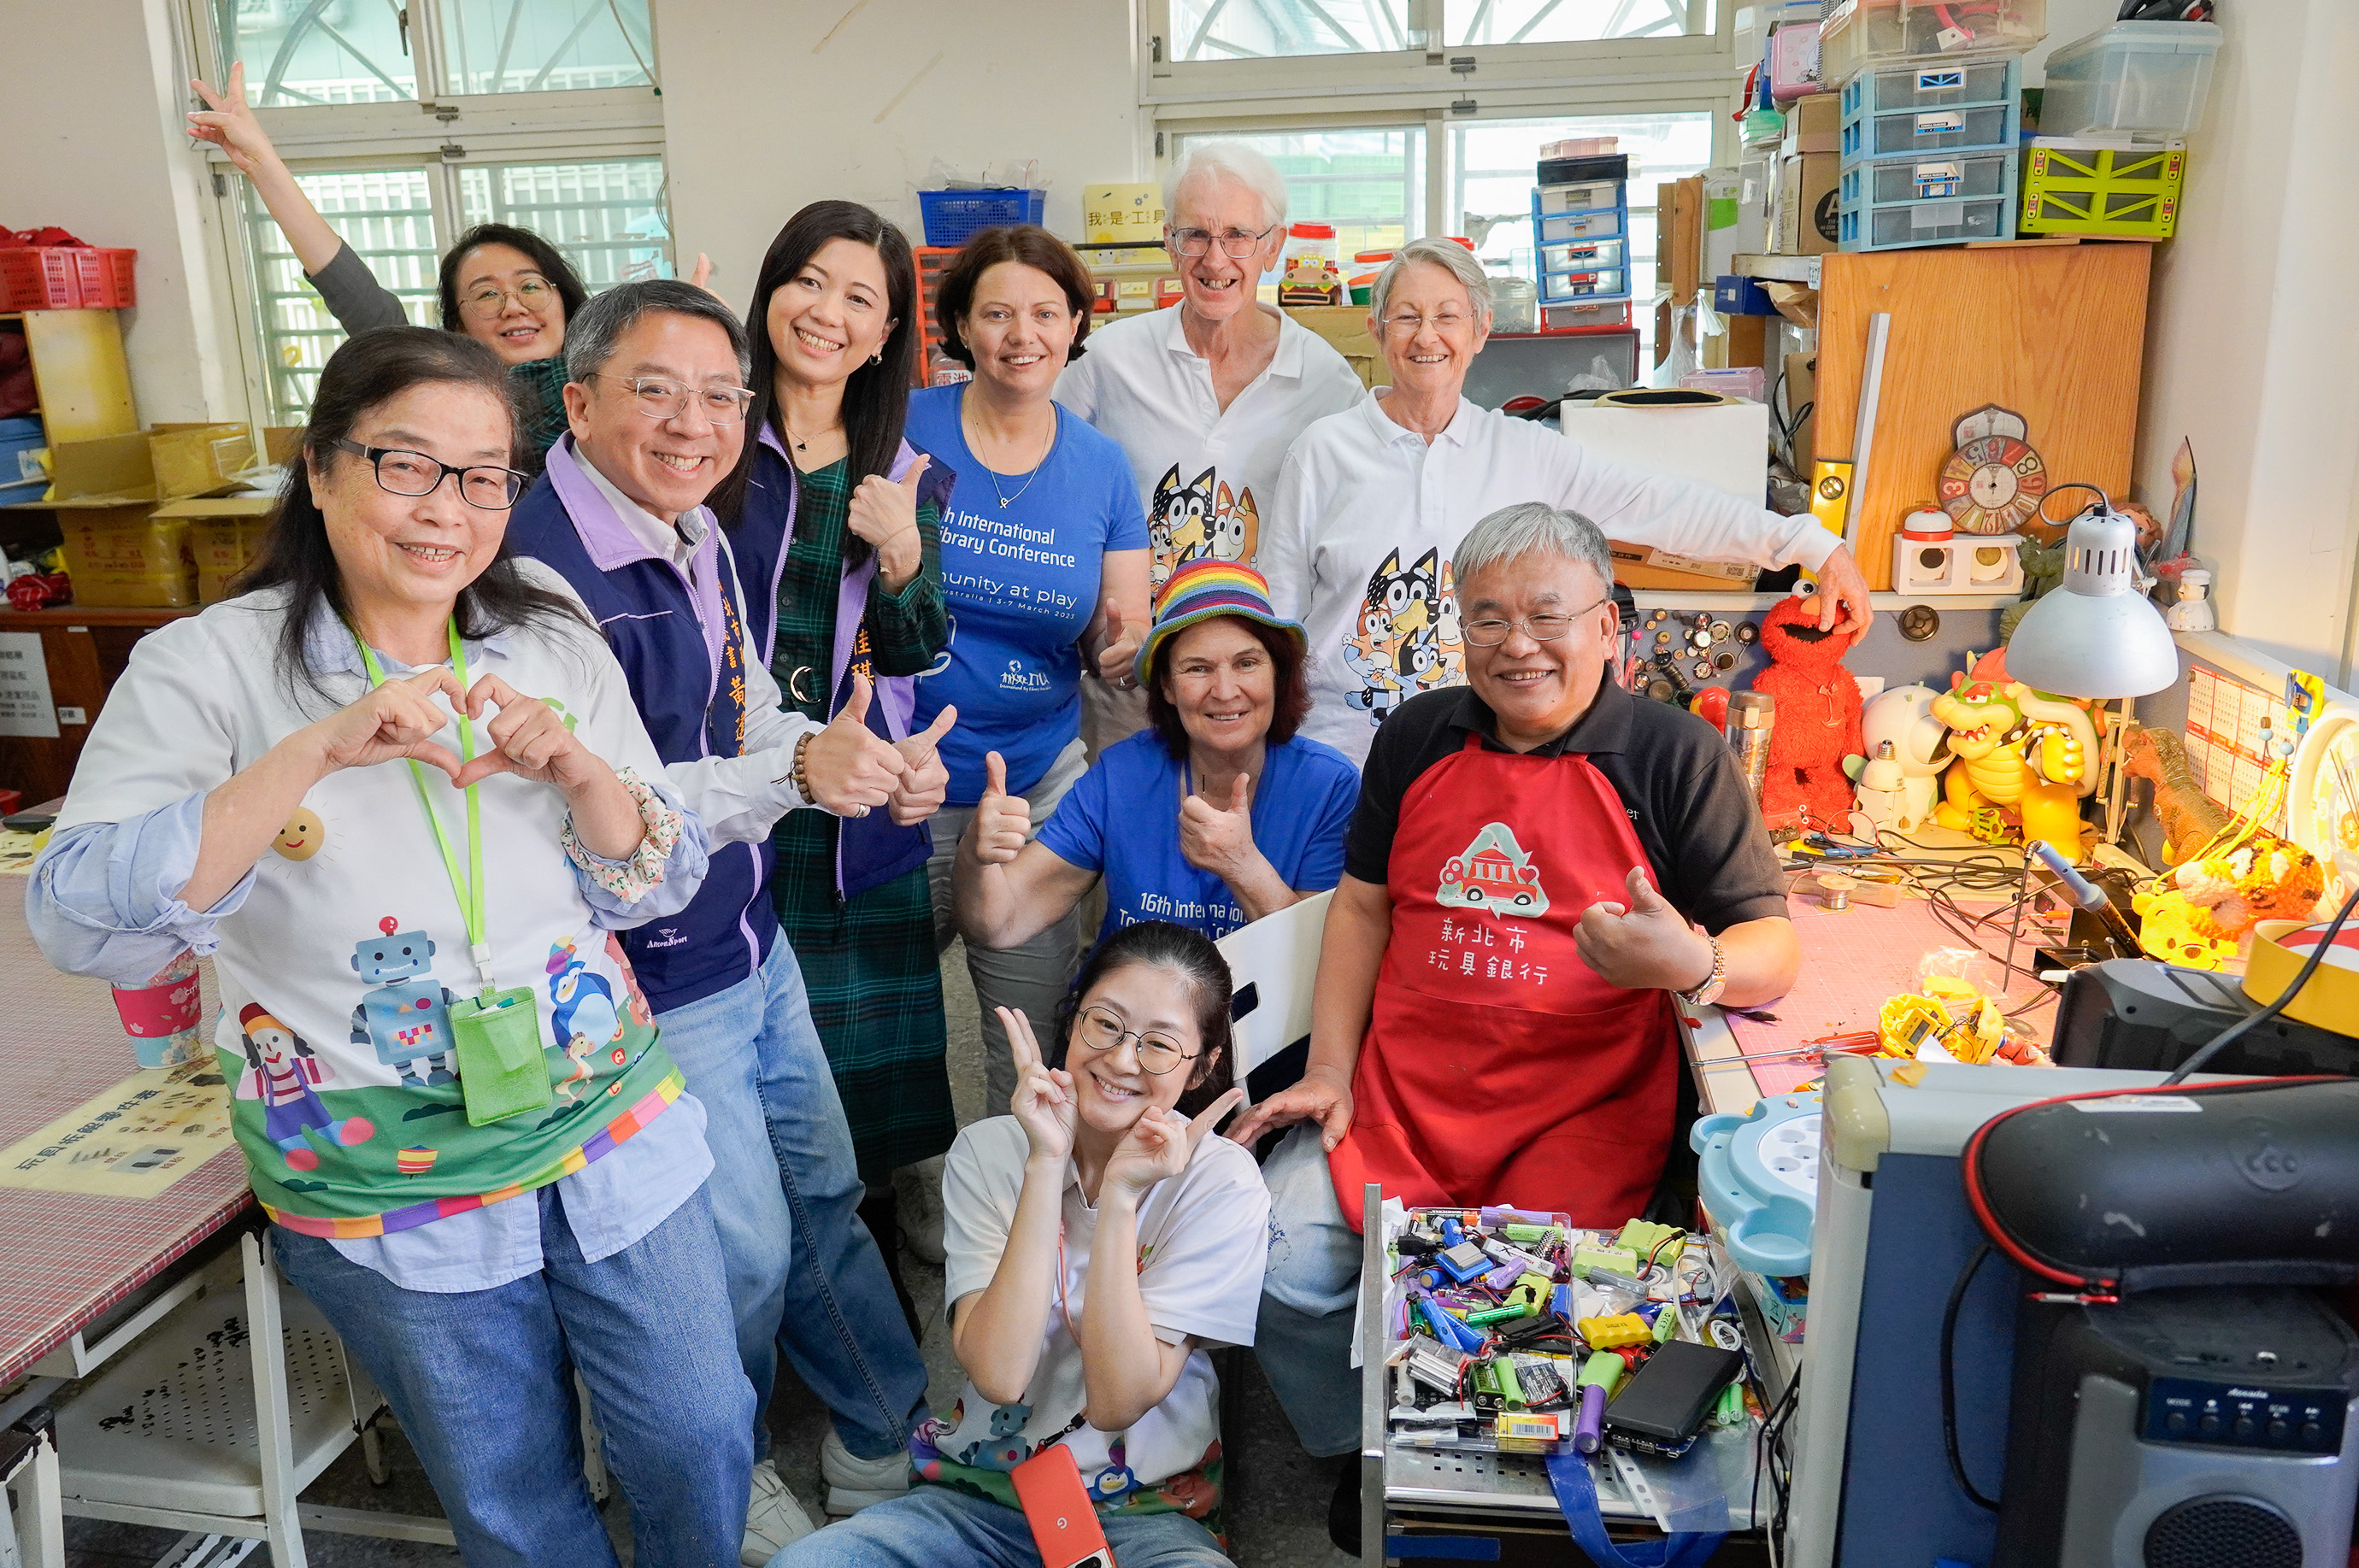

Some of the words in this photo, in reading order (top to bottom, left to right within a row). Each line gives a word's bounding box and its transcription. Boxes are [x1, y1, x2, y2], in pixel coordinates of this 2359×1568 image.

[1088, 210, 1166, 226] 我是工具
[2017, 456, 2038, 475] 8
[1944, 481, 1965, 495] 3
[957, 510, 1055, 545] International
[939, 526, 985, 555] ibrary
[988, 538, 1075, 568] Conference
[996, 598, 1014, 607] 3-7
[1017, 602, 1050, 615] March
[1054, 610, 1075, 620] 2023
[1009, 584, 1030, 598] at
[1036, 589, 1078, 610] play
[2335, 879, 2343, 896] 7
[1140, 892, 1172, 916] 16th
[1441, 918, 1527, 954] 新北市
[1428, 948, 1547, 985] 玩具銀行
